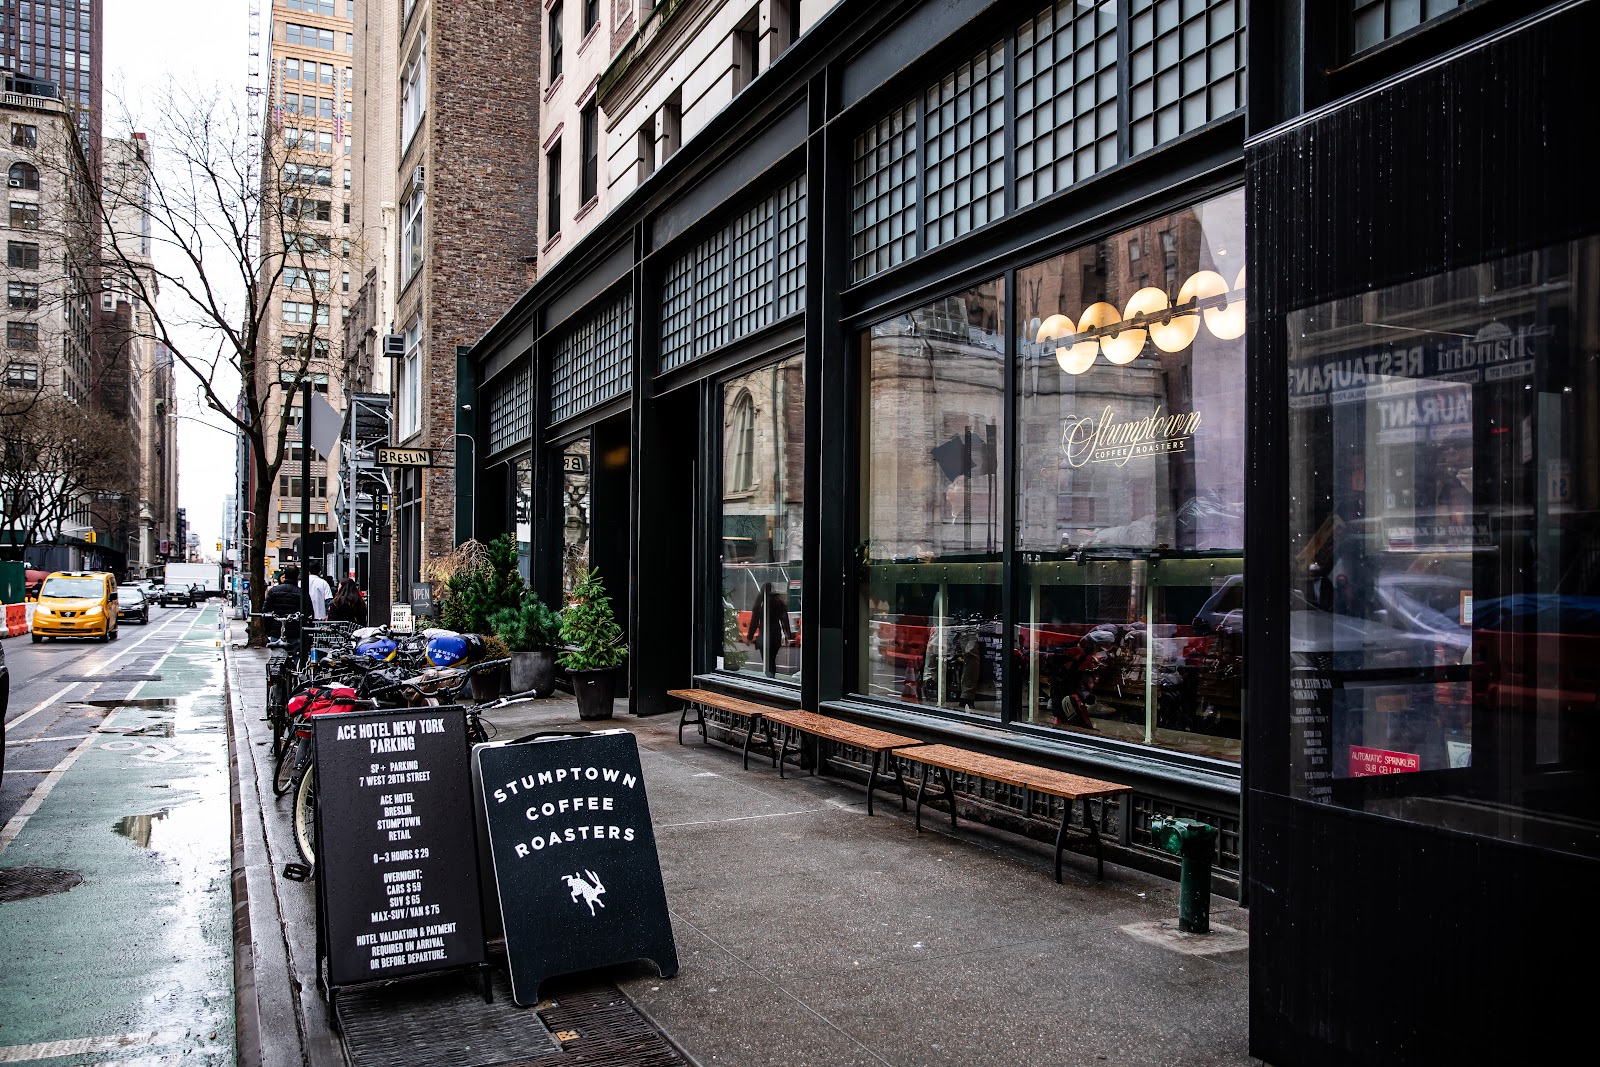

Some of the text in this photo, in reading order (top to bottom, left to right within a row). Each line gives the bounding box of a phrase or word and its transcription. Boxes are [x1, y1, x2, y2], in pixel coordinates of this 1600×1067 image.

[1062, 405, 1202, 467] Stumptown
[380, 450, 427, 464] BRESLIN
[1095, 440, 1184, 459] COFFEE ROASTERS
[413, 588, 430, 601] OPEN
[337, 718, 445, 740] ACE HOTEL NEW YORK
[370, 736, 416, 754] PARKING
[390, 760, 418, 772] PARKING
[1351, 751, 1416, 768] AUTOMATIC SPRINKLER
[1365, 763, 1376, 773] SUB
[359, 770, 431, 787] 7 WEST 28TH STREET
[493, 766, 637, 803] STUMPTOWN
[380, 792, 415, 805] ACE HOTEL
[384, 805, 412, 817] BRESLIN
[526, 797, 614, 820] COFFEE
[377, 816, 421, 830] STUMPTOWN
[388, 829, 411, 841] RETAIL
[514, 825, 635, 858] ROASTERS
[391, 849, 413, 862] HOURS
[383, 869, 423, 883] OVERNIGHT:
[386, 883, 405, 896] CARS
[389, 896, 404, 908] SUV
[356, 922, 457, 946] HOTEL VALIDATION & PAYMENT
[371, 936, 444, 957] REQUIRED ON ARRIVAL
[370, 949, 447, 970] OR BEFORE DEPARTURE.
